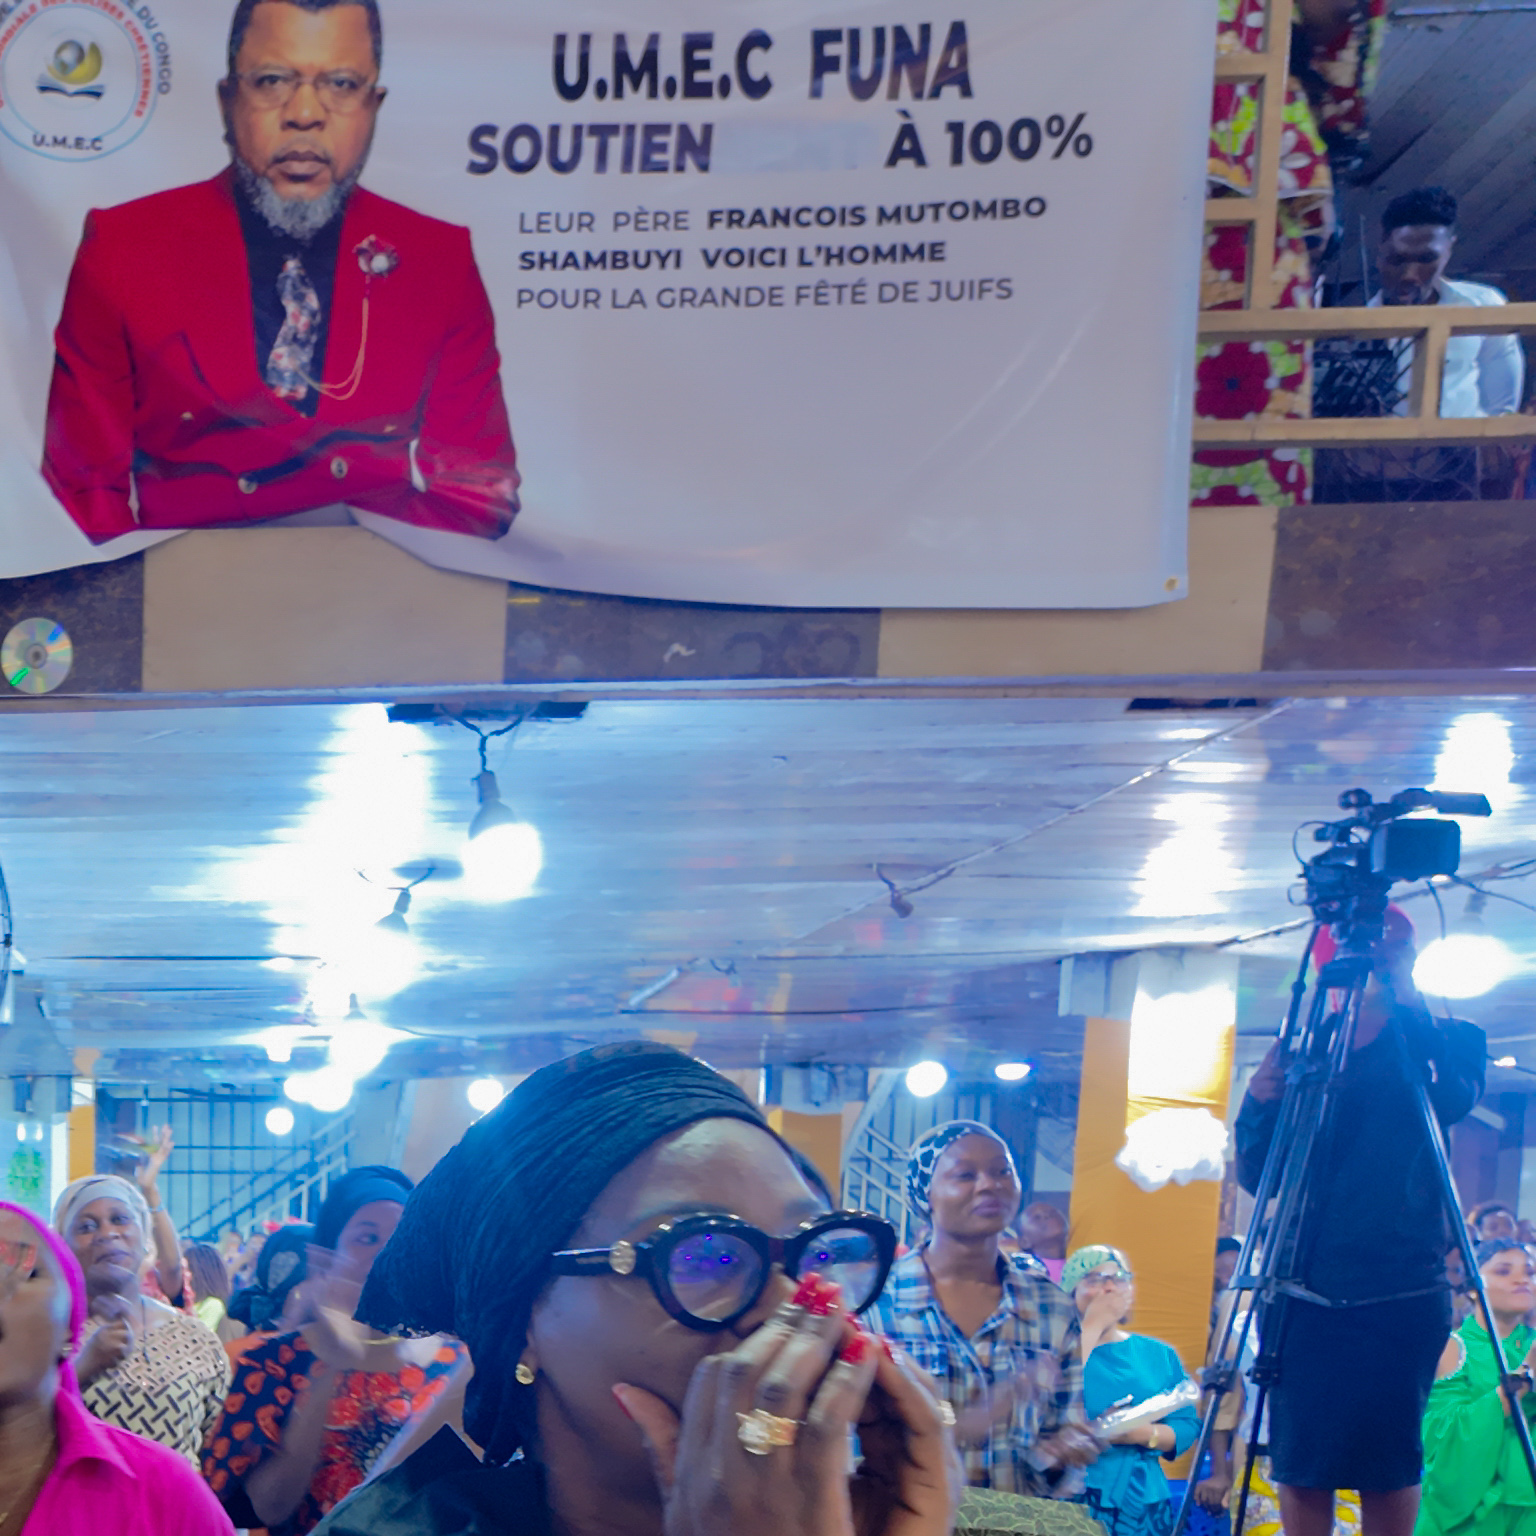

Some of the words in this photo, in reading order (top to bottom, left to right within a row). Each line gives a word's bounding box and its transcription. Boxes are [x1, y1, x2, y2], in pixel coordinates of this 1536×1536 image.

[137, 6, 159, 30] DU
[152, 32, 172, 95] CONGO
[553, 30, 773, 102] U.M.E.C
[809, 20, 974, 102] FUNA
[33, 133, 103, 151] U.M.E.C
[467, 123, 714, 175] SOUTIEN
[885, 110, 928, 168] À
[946, 113, 1094, 167] 100%
[518, 211, 596, 235] LEUR
[612, 205, 690, 233] PÈRE
[707, 205, 867, 230] FRANCOIS
[876, 197, 1047, 227] MUTOMBO
[519, 248, 682, 271] SHAMBUYI
[701, 246, 787, 269] VOICI
[517, 288, 602, 310] POUR
[610, 288, 648, 310] LA
[656, 286, 785, 309] GRANDE
[795, 277, 868, 307] FÊTÉ
[877, 280, 919, 304] DE
[927, 278, 1014, 303] JUIFS
